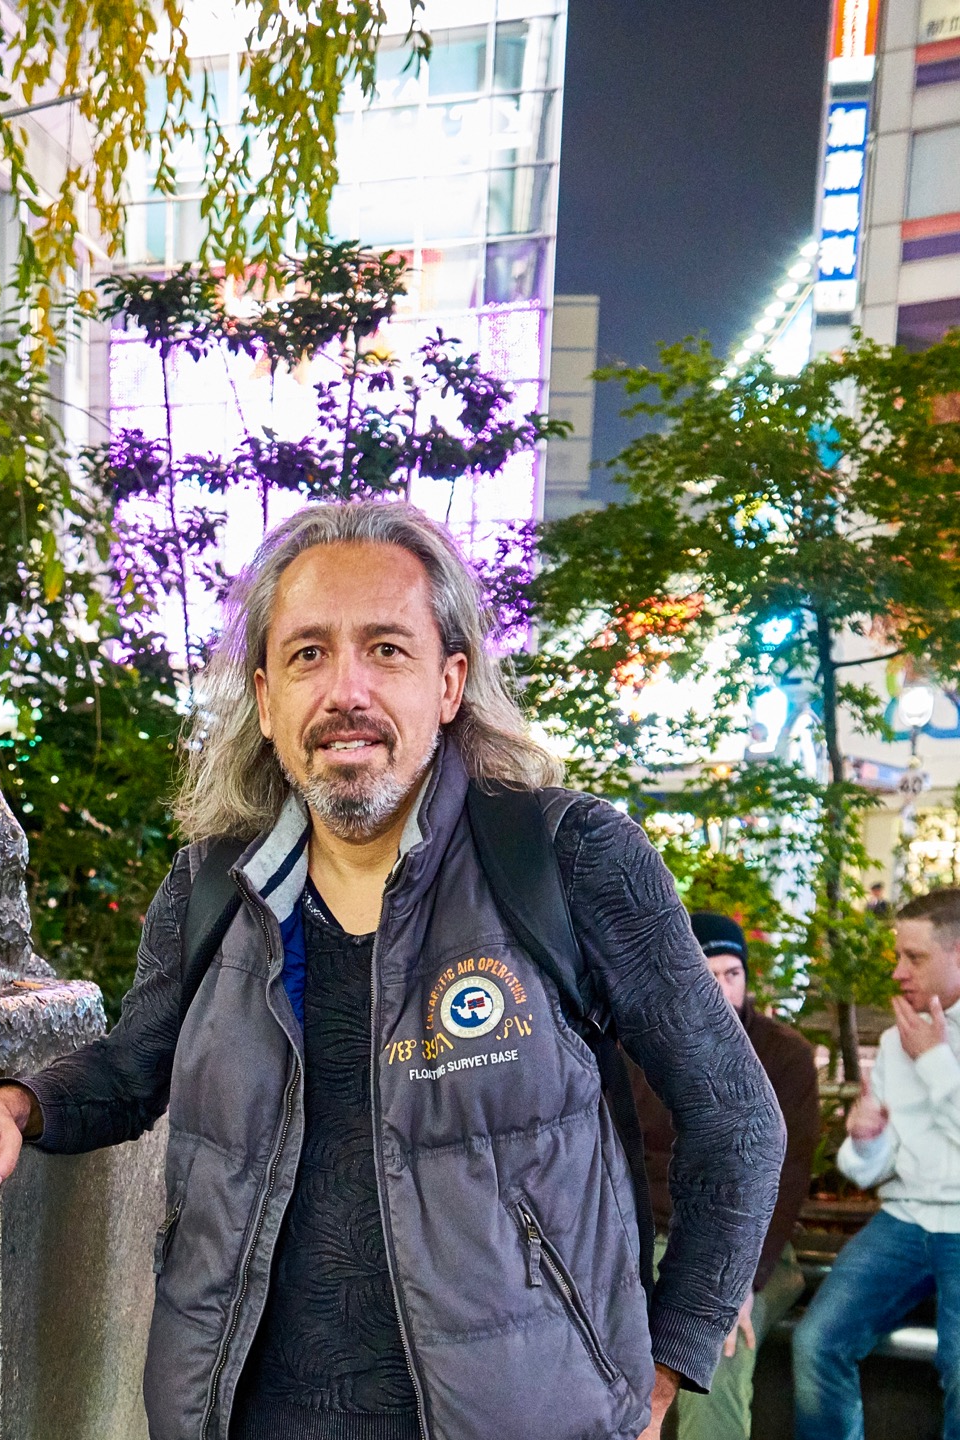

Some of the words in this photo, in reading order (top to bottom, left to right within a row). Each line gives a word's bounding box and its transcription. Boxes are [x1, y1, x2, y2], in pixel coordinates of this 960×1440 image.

[457, 958, 475, 975] AIR
[409, 1065, 446, 1081] FLOATING
[447, 1054, 489, 1072] SURVEY
[490, 1049, 519, 1064] BASE
